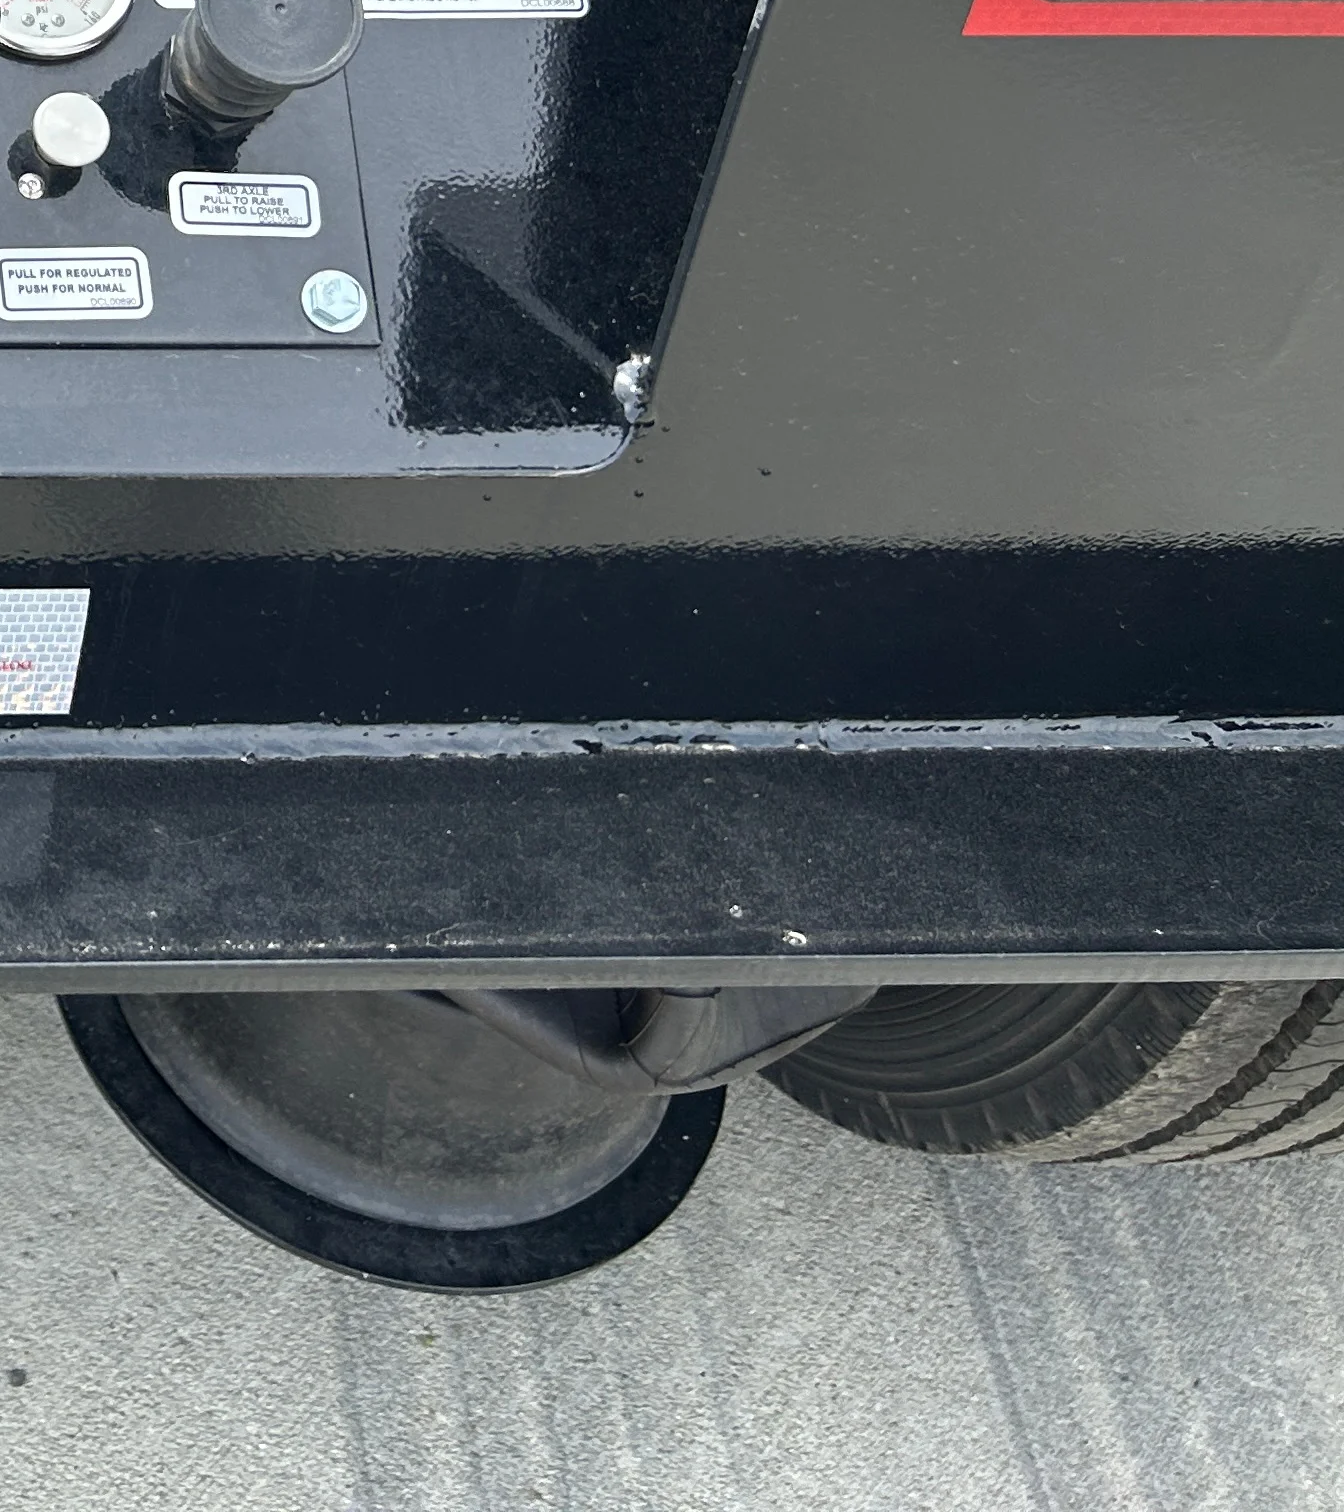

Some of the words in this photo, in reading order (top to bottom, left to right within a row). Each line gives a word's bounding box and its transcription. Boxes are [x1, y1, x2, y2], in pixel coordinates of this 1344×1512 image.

[86, 11, 101, 26] 160
[217, 186, 238, 194] 3RD
[241, 186, 269, 196] AXLE
[204, 196, 232, 204] PULL
[235, 196, 248, 204] TO
[252, 197, 284, 206] RAISE
[200, 205, 228, 213] PUSH
[232, 206, 247, 214] TO
[250, 207, 290, 215] LOWER
[8, 269, 36, 278] PULL
[40, 269, 62, 278] FOR
[66, 268, 132, 277] REGULATED
[18, 285, 48, 293] PUSH
[52, 284, 74, 293] FOR
[79, 284, 126, 293] NORMAL
